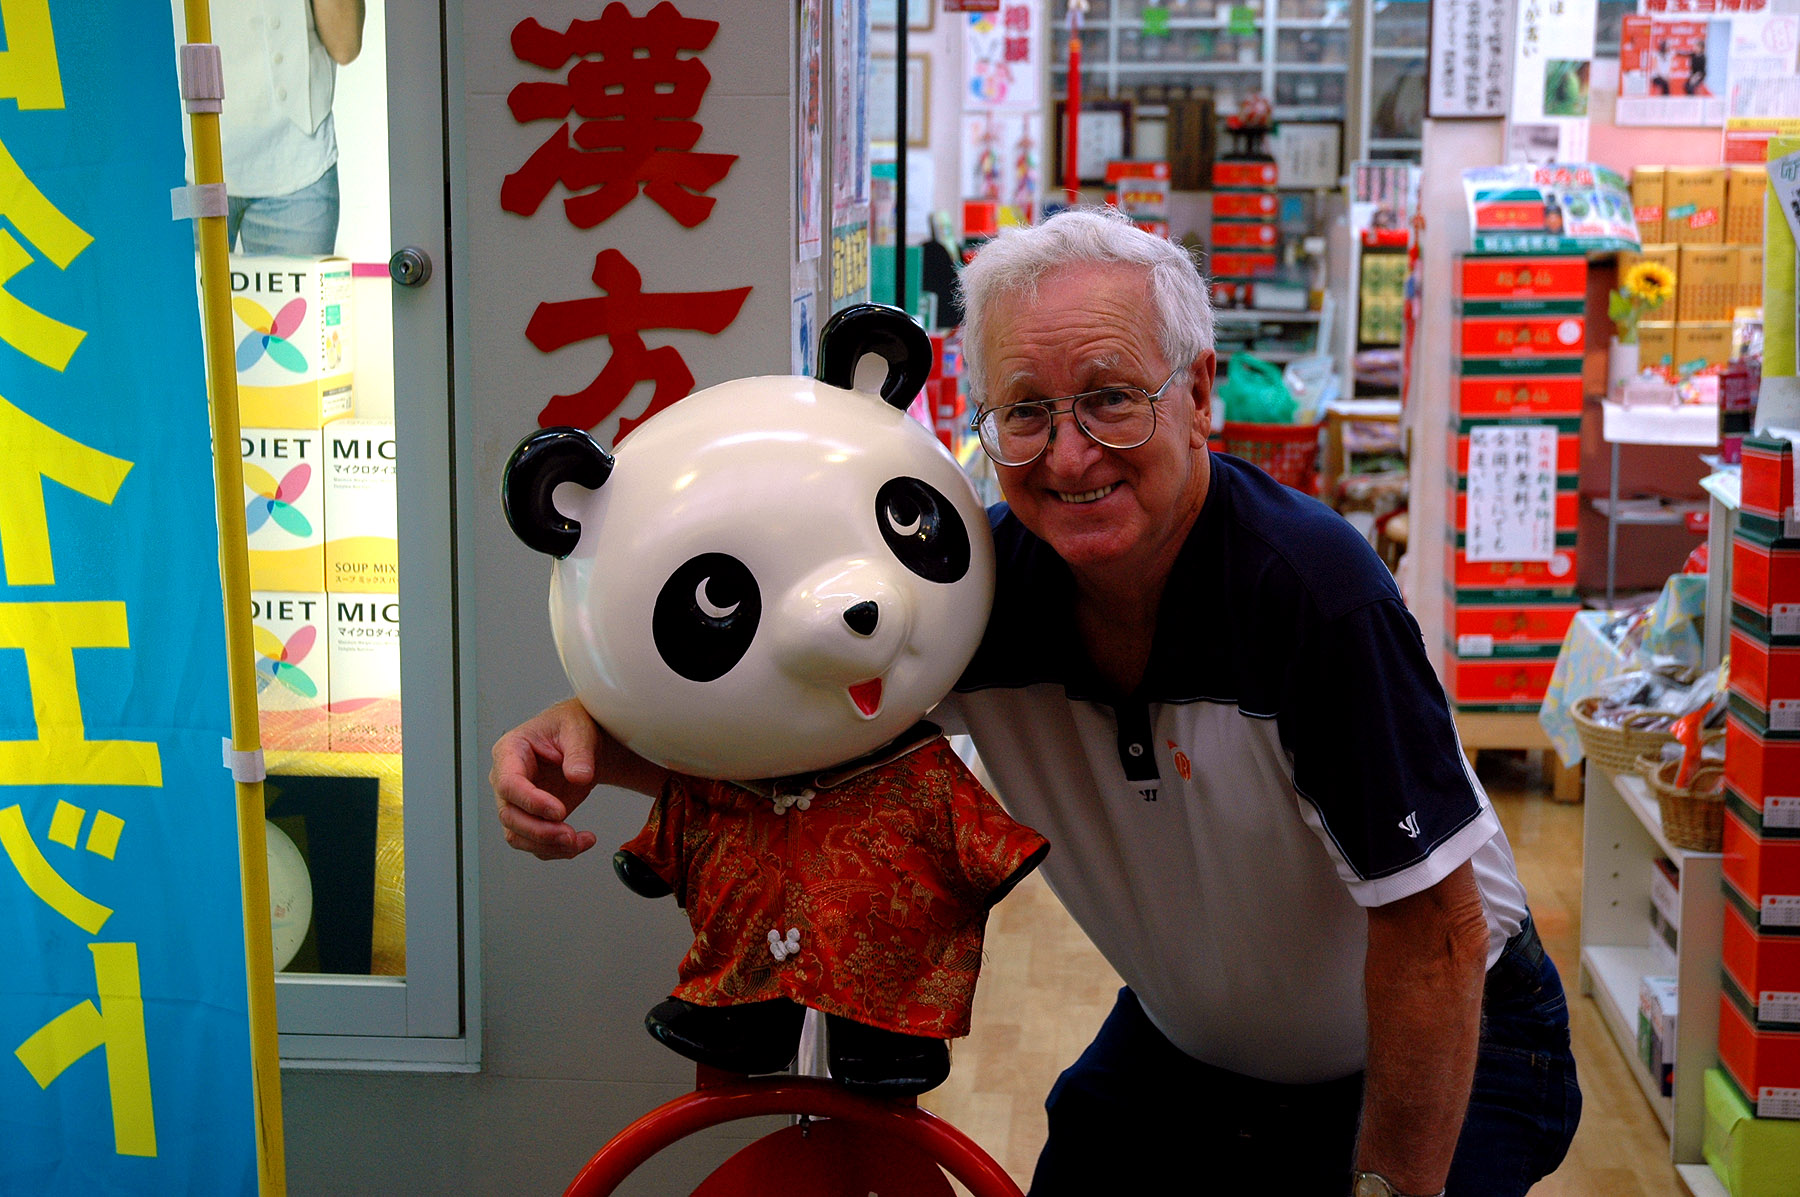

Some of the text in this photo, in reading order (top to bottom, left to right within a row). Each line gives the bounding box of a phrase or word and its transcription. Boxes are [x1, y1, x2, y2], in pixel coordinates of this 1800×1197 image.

[500, 1, 753, 447] 漢方
[335, 562, 396, 574] SOUP MIX
